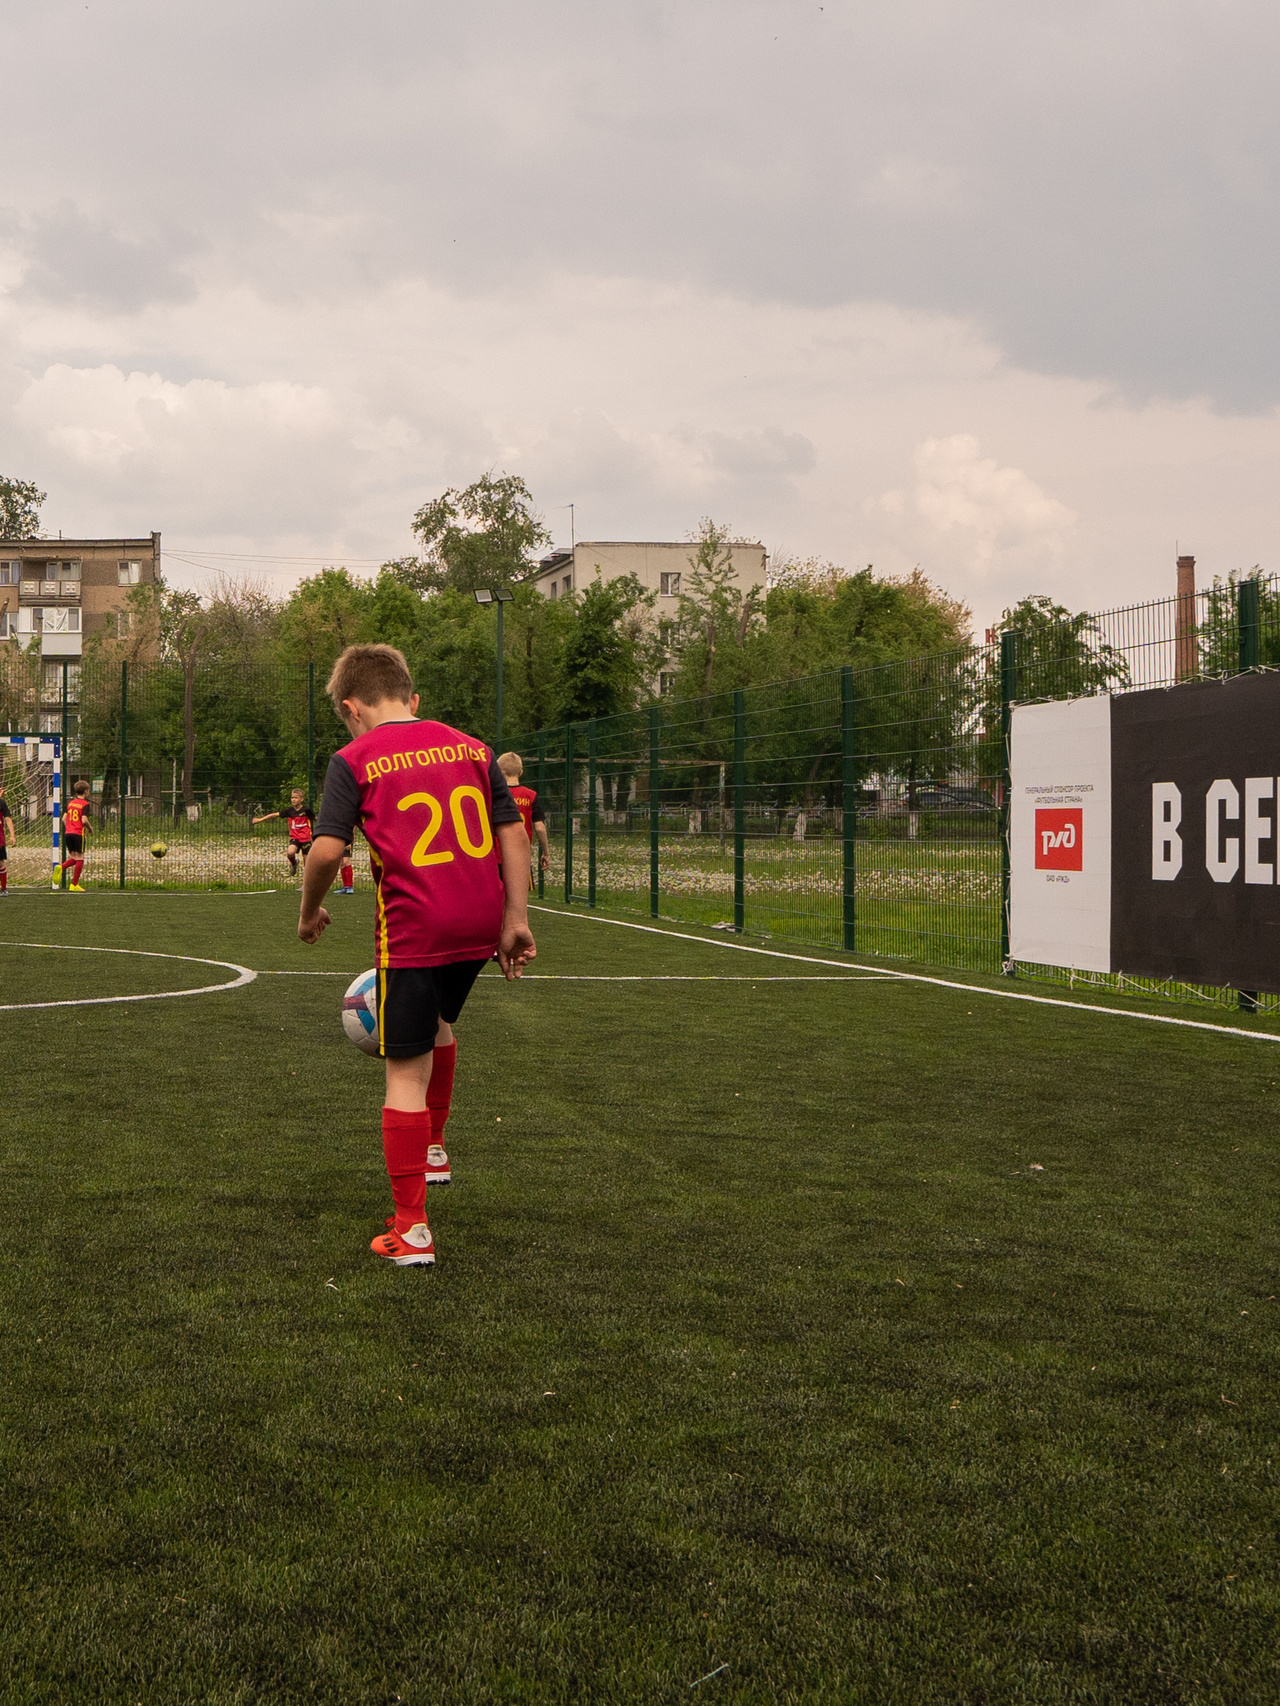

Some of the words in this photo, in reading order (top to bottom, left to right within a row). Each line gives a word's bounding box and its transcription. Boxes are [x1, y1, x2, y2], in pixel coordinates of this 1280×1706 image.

[67, 808, 79, 822] 18
[397, 785, 493, 867] 20
[1151, 782, 1183, 881] В
[1205, 776, 1280, 886] СЕ
